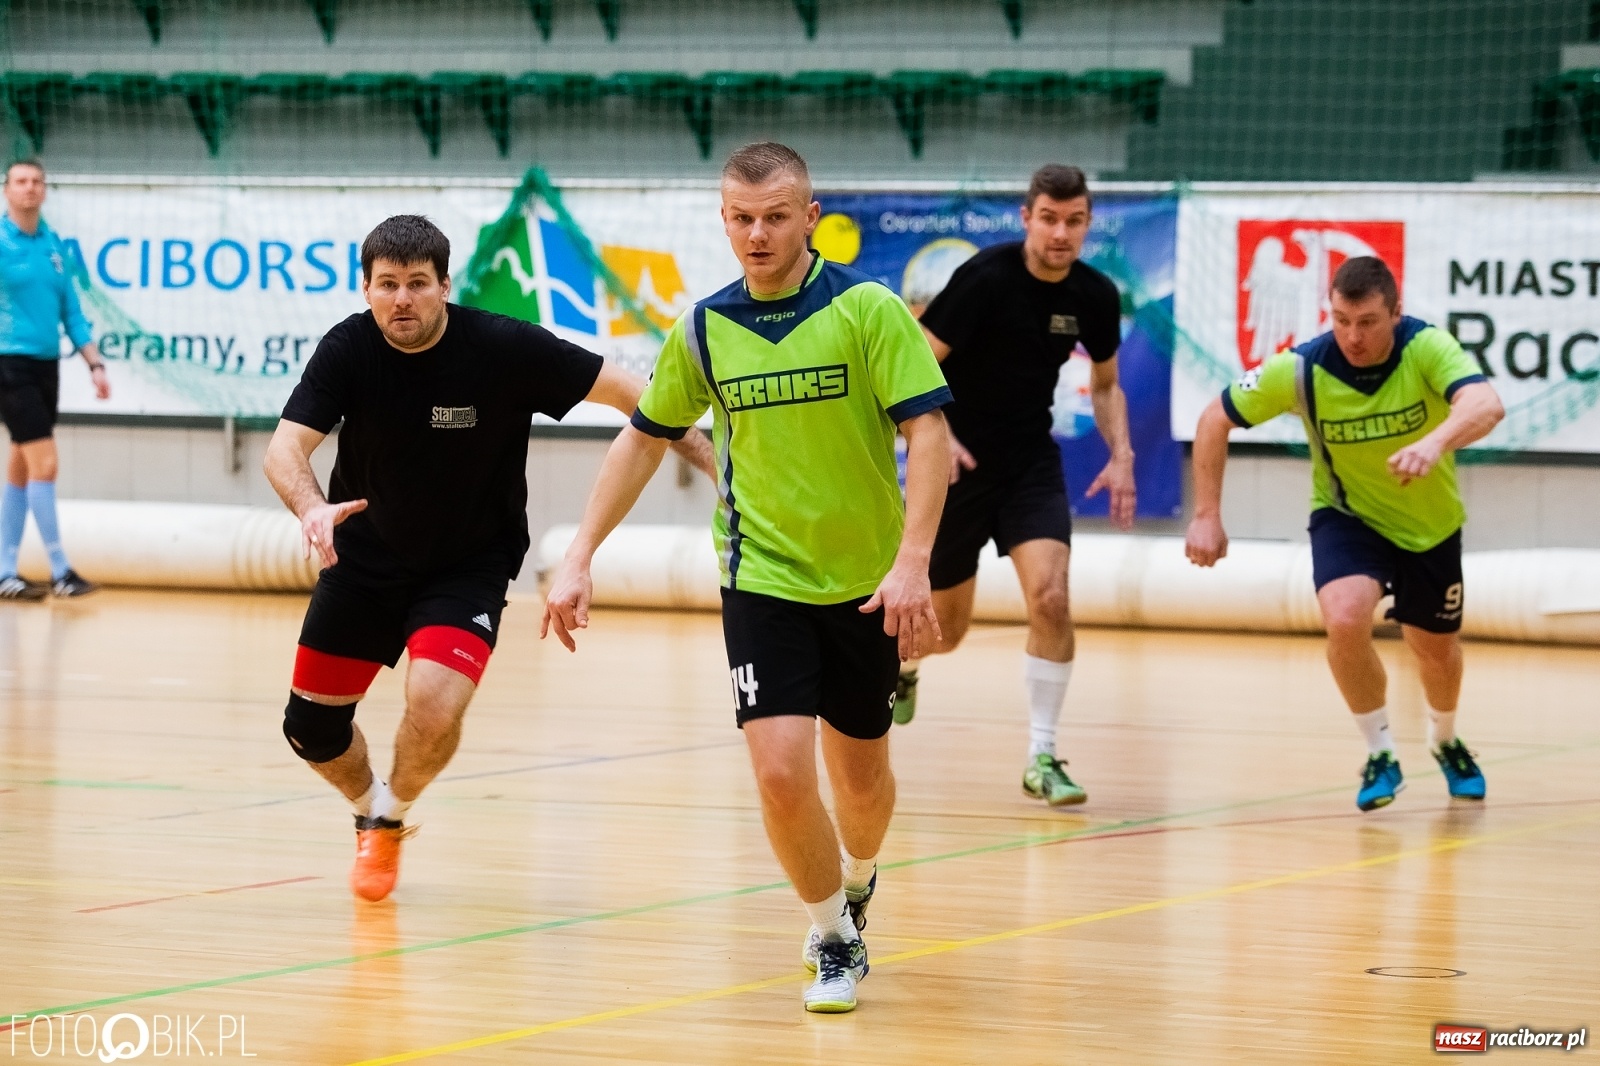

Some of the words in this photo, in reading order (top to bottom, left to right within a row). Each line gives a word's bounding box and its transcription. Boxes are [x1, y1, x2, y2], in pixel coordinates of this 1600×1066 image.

[1449, 258, 1600, 297] MIAST
[755, 311, 796, 323] regio
[261, 333, 321, 376] gr
[1447, 311, 1600, 381] Rac
[719, 366, 847, 410] BRUKS
[431, 421, 476, 429] www.staltech.pl
[1444, 581, 1462, 611] 9
[731, 663, 759, 711] 14
